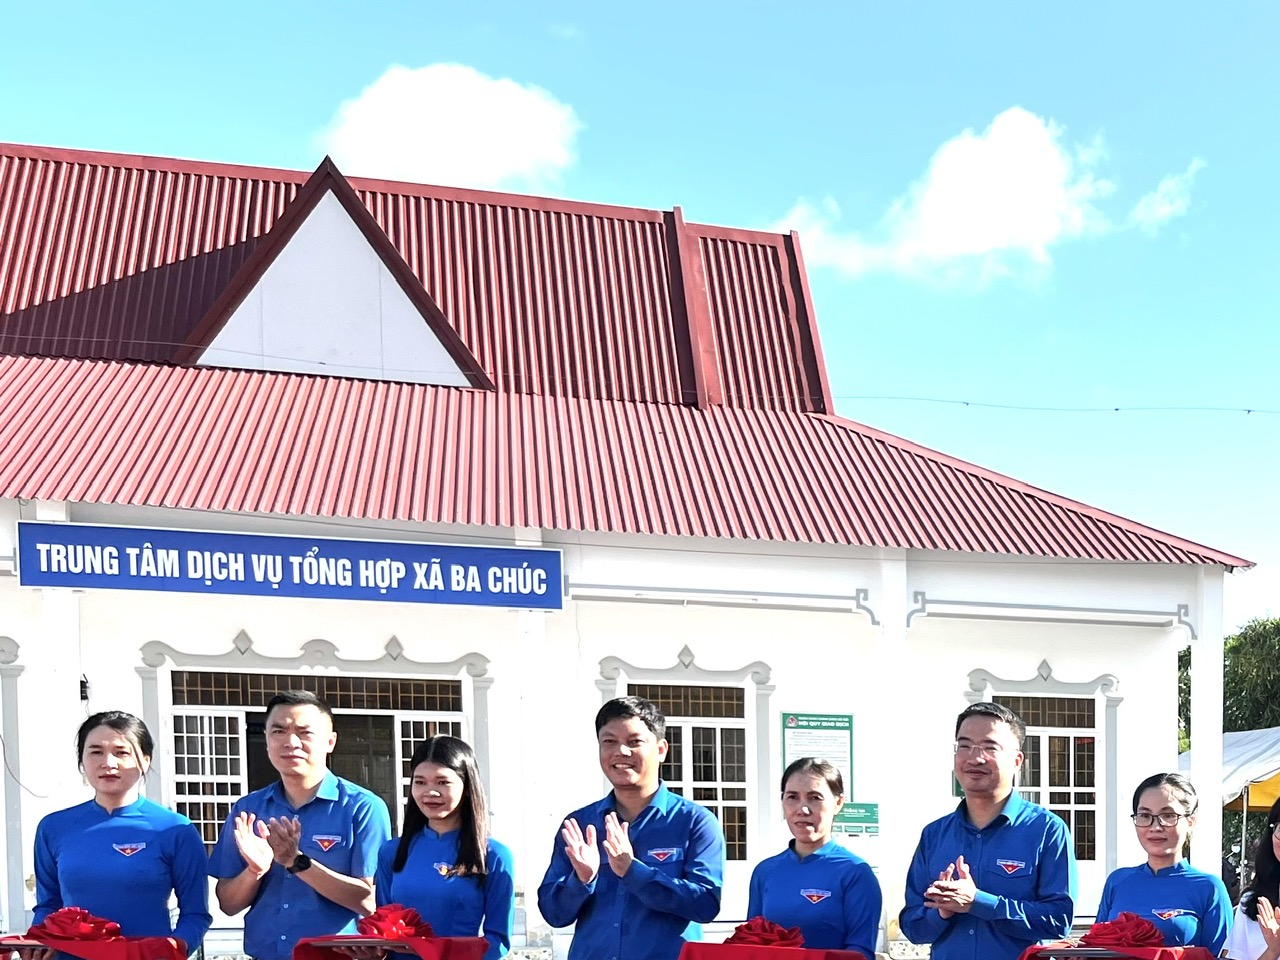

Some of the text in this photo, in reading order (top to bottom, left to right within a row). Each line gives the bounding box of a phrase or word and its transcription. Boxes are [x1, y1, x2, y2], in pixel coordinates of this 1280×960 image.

[36, 542, 548, 596] TRUNG TÂM DỊCH VỤ TỔNG HỢP XÃ BA CHÚC
